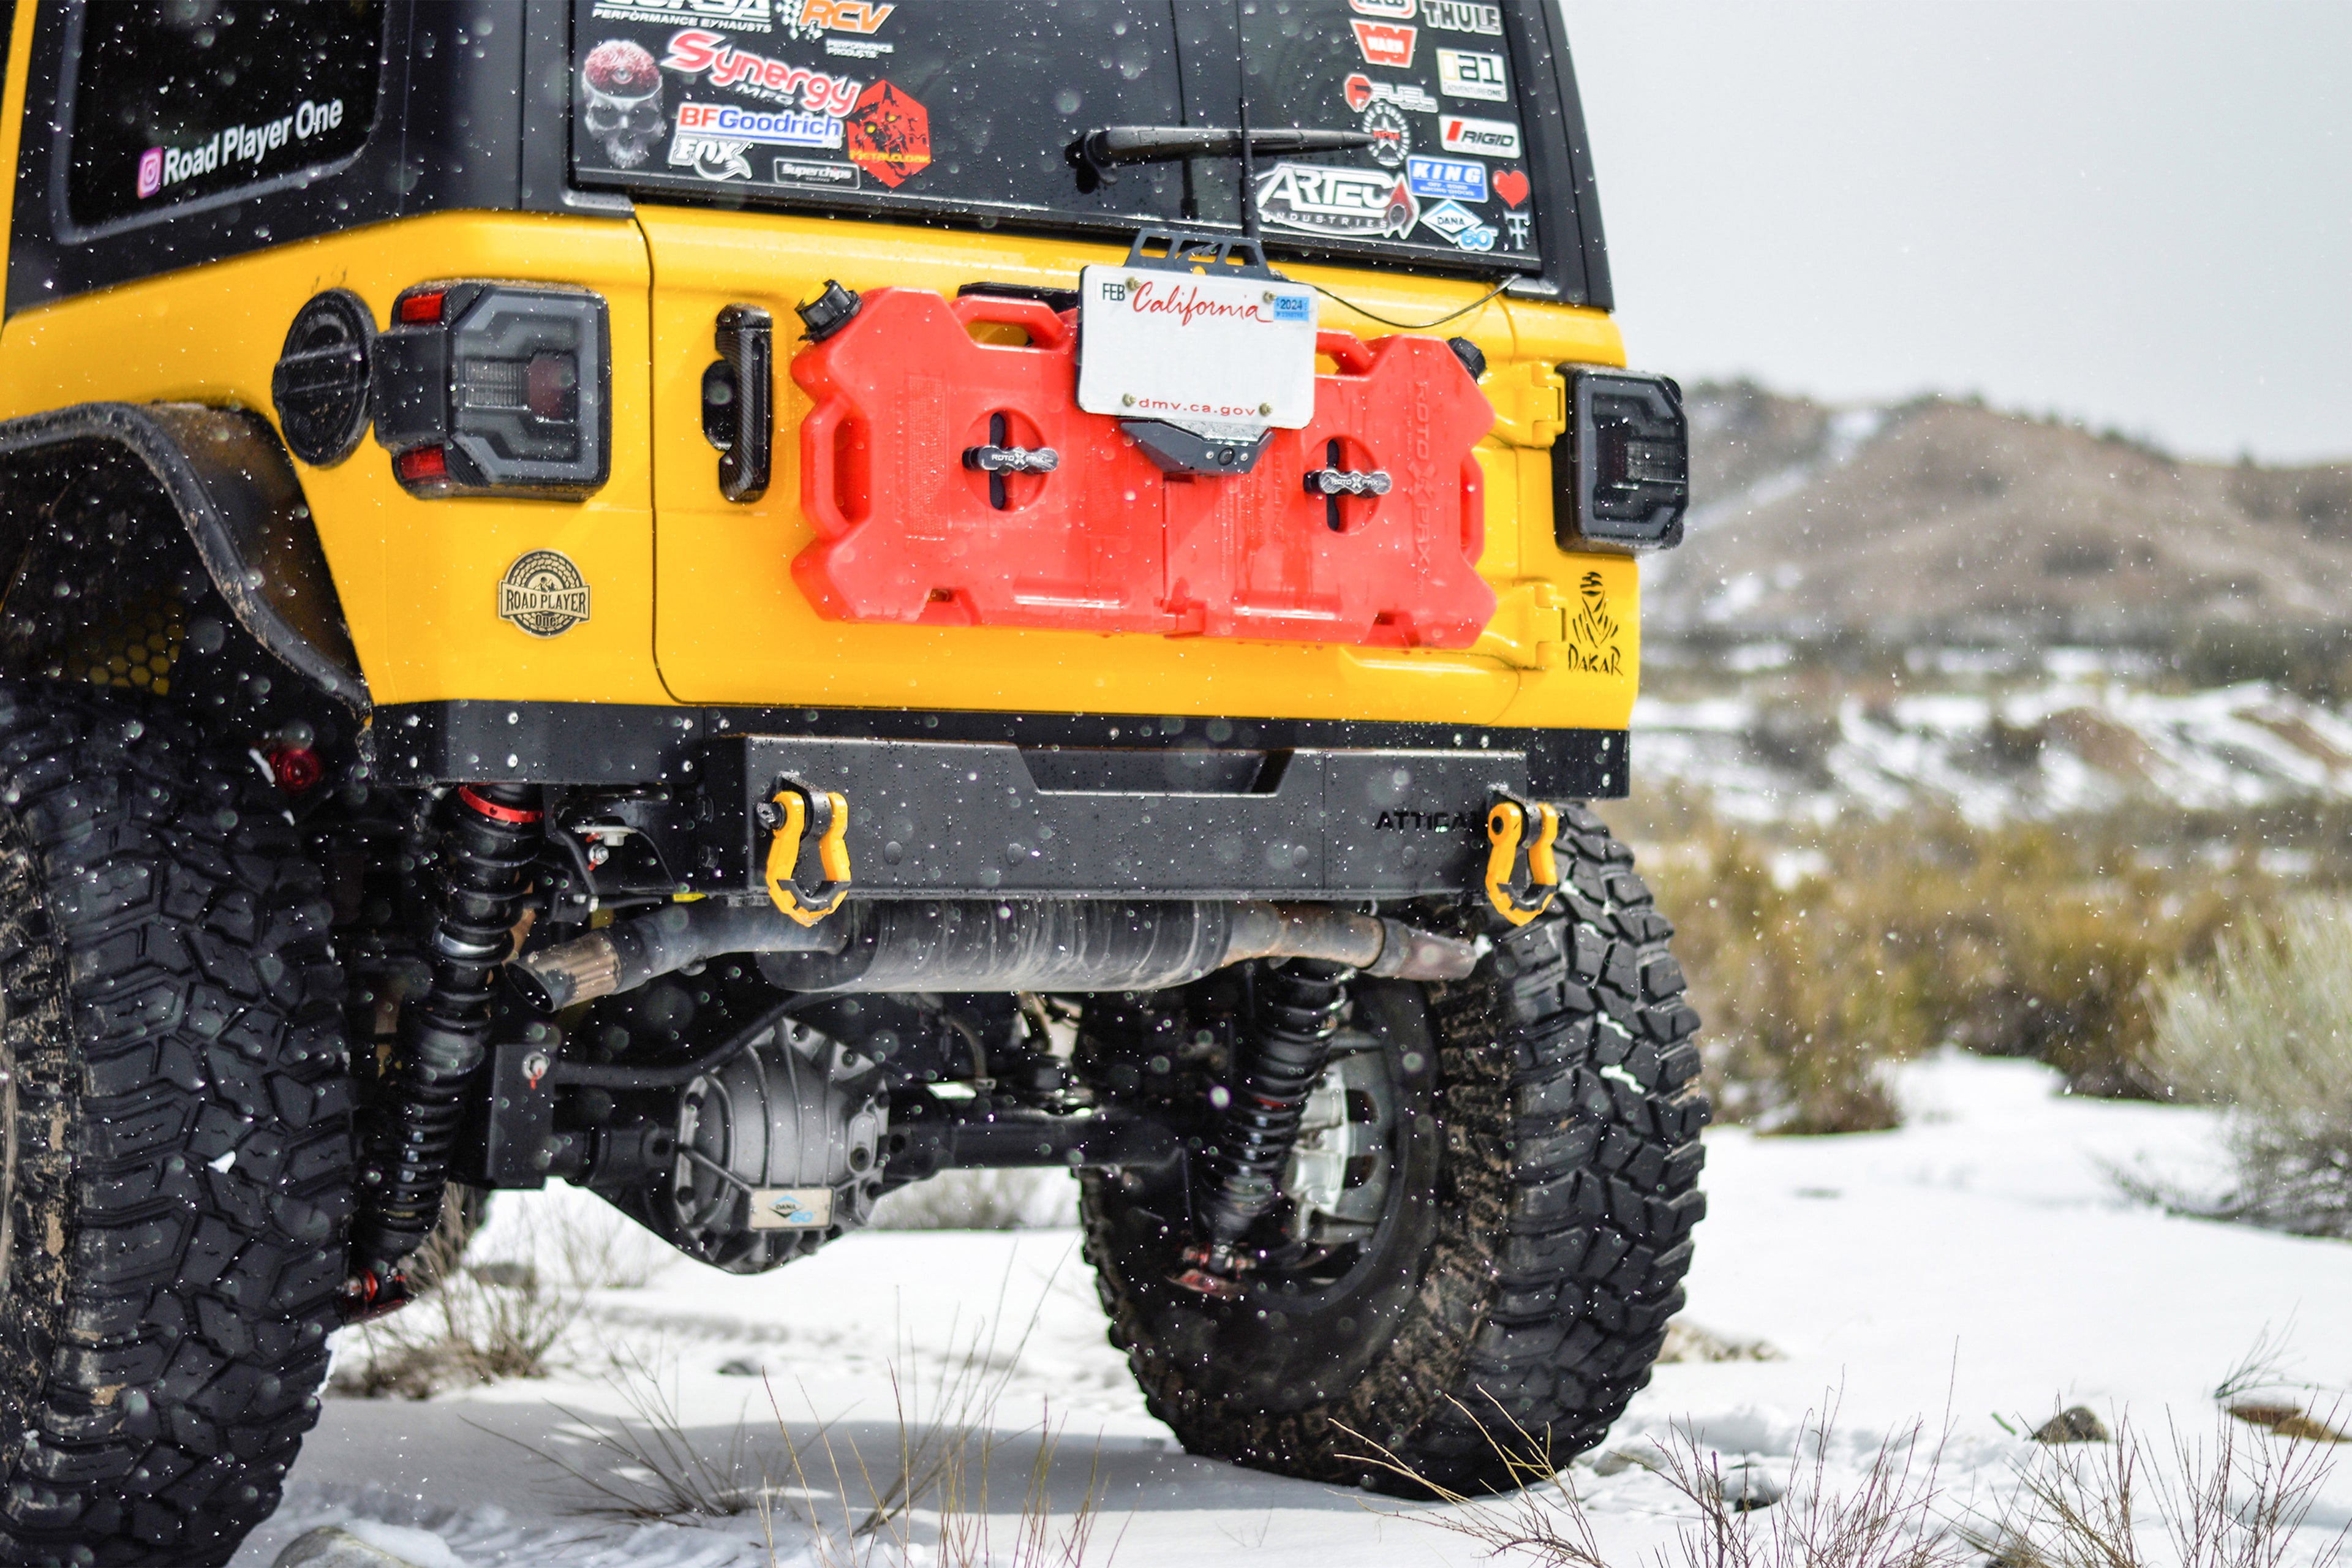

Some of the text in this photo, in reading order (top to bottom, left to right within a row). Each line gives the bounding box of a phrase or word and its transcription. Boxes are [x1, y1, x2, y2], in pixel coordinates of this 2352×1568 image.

[592, 8, 698, 26] PERFORMANCE
[798, 0, 897, 34] RCV
[1422, 1, 1500, 33] THULE
[1366, 37, 1404, 54] WARN
[660, 29, 862, 118] Synergy
[735, 83, 794, 105] MFG
[1372, 83, 1436, 104] FUEL
[679, 106, 840, 135] BFGoodrich
[163, 98, 343, 186] Road Player One
[1373, 130, 1400, 140] RPM
[674, 136, 748, 167] FOX
[782, 163, 852, 180] Superchips
[1412, 162, 1481, 184] KING
[1257, 165, 1393, 211] ARTEC
[1263, 211, 1387, 229] INDUSTRIES
[1437, 217, 1492, 247] DANA 60
[1102, 281, 1302, 326] FEB California 2024
[1139, 398, 1256, 417] dmv.ca.gov
[507, 589, 586, 614] ROAD PLAYER
[535, 614, 556, 627] One
[1569, 643, 1623, 676] DAKAR
[790, 1211, 813, 1223] 60
